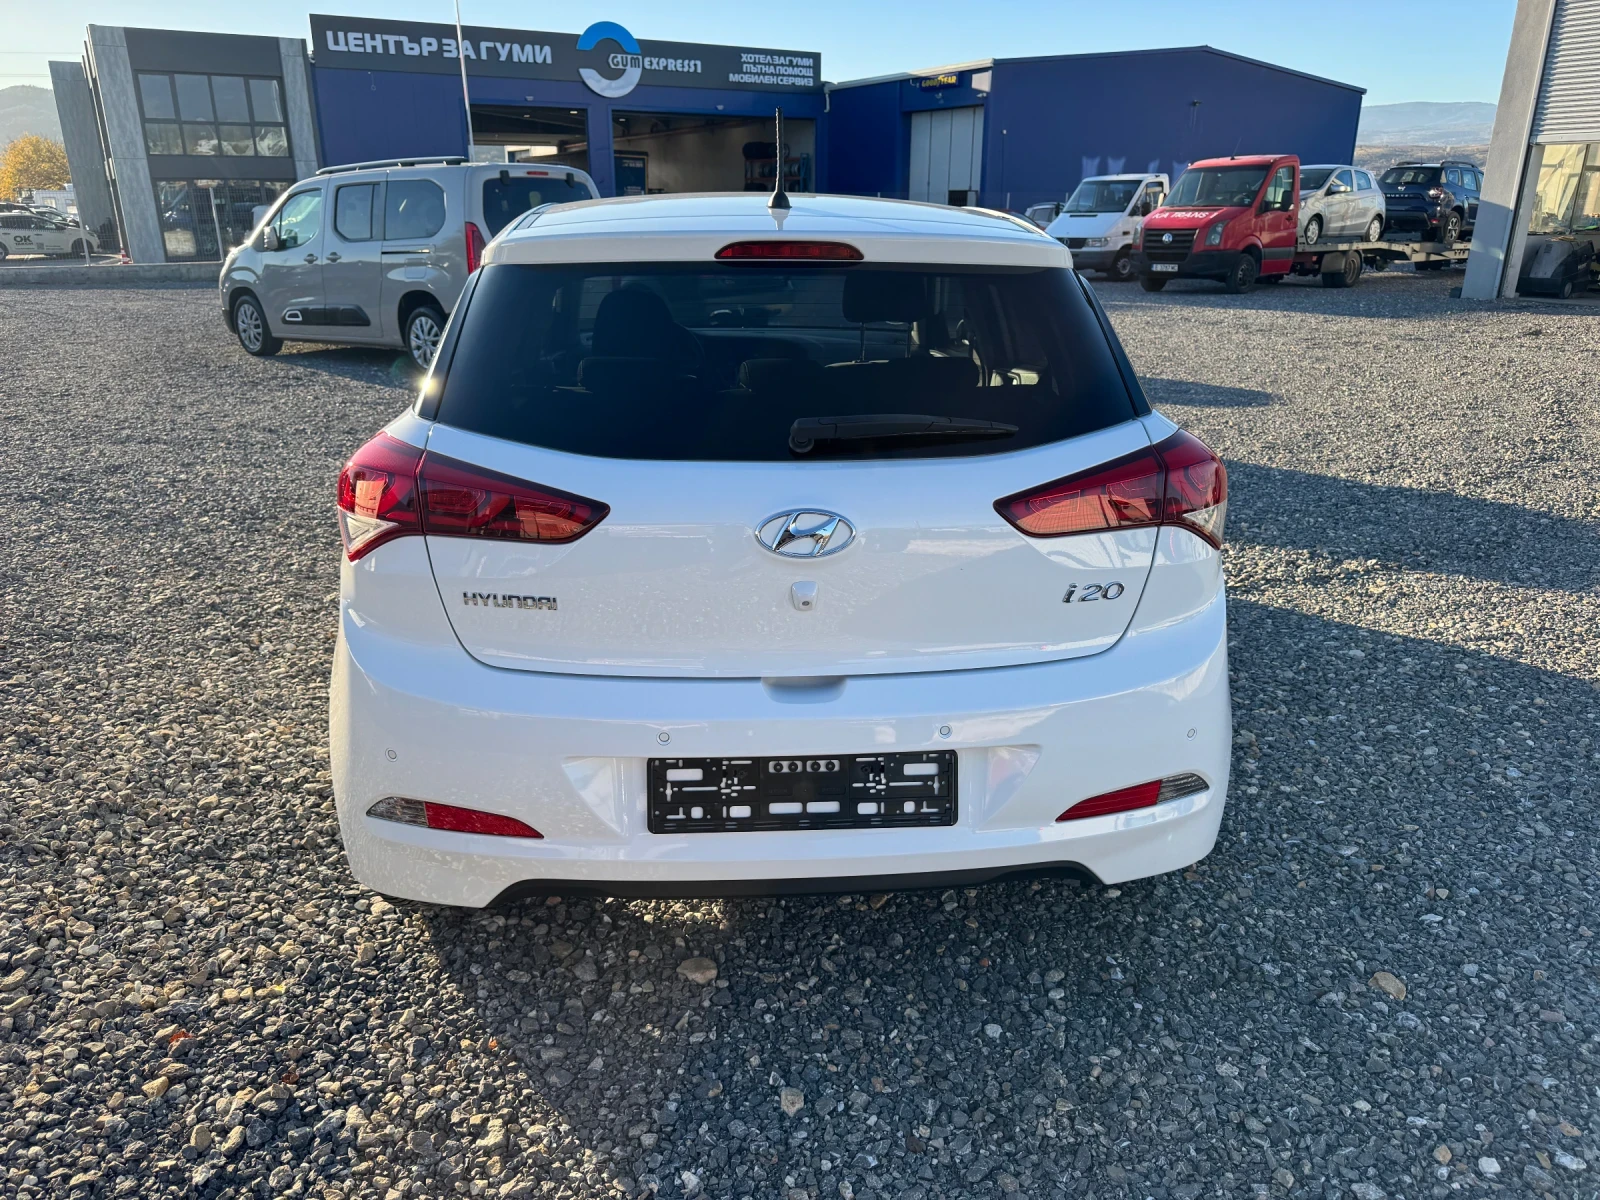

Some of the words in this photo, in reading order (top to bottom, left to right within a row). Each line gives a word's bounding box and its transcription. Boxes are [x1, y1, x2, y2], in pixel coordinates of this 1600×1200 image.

[326, 30, 438, 57] ЦЕНТЪР
[442, 38, 477, 60] ЗА
[479, 41, 553, 64] ГУМИ
[611, 55, 640, 68] GUM
[741, 53, 772, 64] ХОТЕЛ
[772, 55, 786, 66] ЗА
[786, 56, 814, 67] ГУМИ
[743, 63, 776, 74] ПЪТНА
[776, 66, 814, 76] ПОМОЩ
[729, 73, 777, 84] МОБИЛЕН
[777, 76, 814, 86] СЕРВИЗ
[1062, 580, 1125, 604] i20
[462, 591, 558, 611] HYUNDAI
